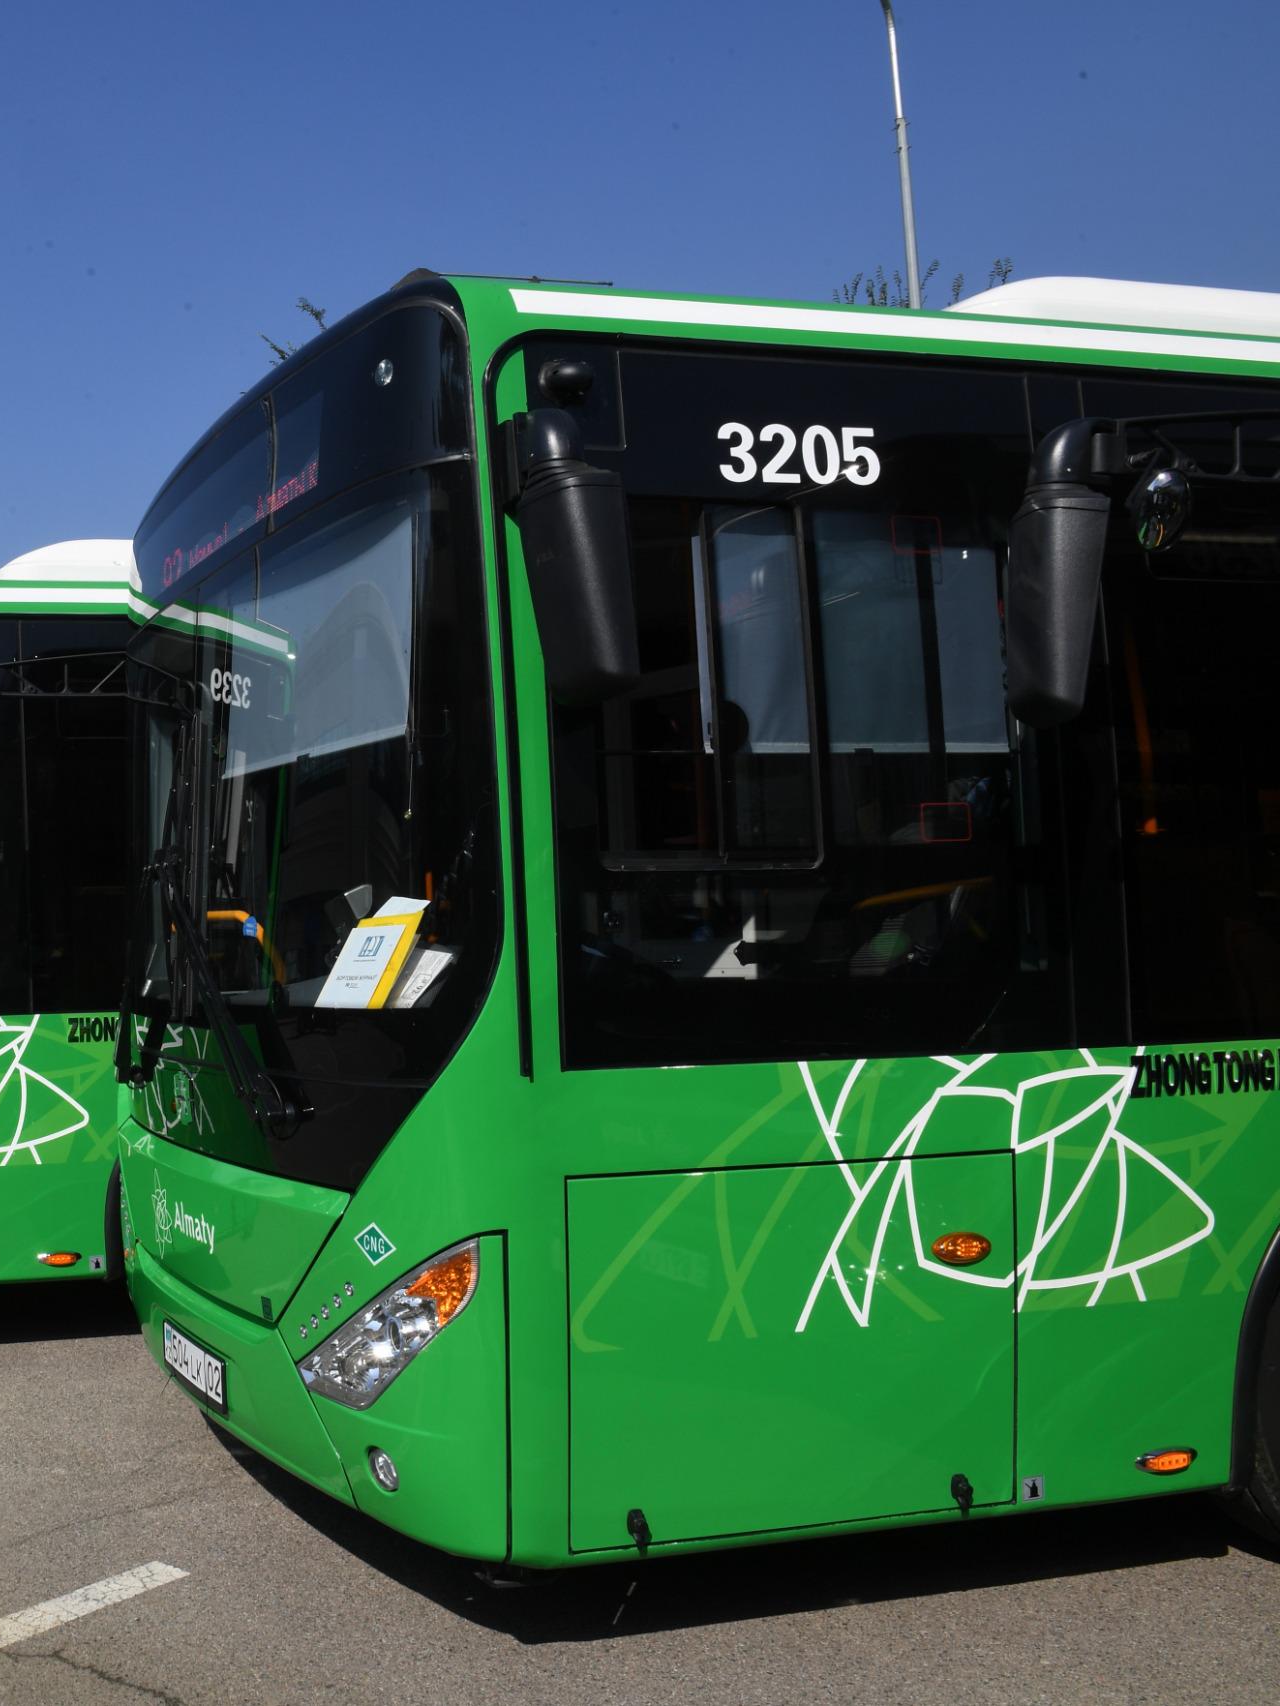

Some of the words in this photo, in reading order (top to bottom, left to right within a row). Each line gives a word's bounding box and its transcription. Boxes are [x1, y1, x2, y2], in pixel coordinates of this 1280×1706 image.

[717, 422, 881, 486] 3205
[68, 1016, 120, 1043] ZHON
[174, 1201, 216, 1254] Almaty
[362, 1234, 386, 1255] CNG
[206, 1361, 222, 1398] 02
